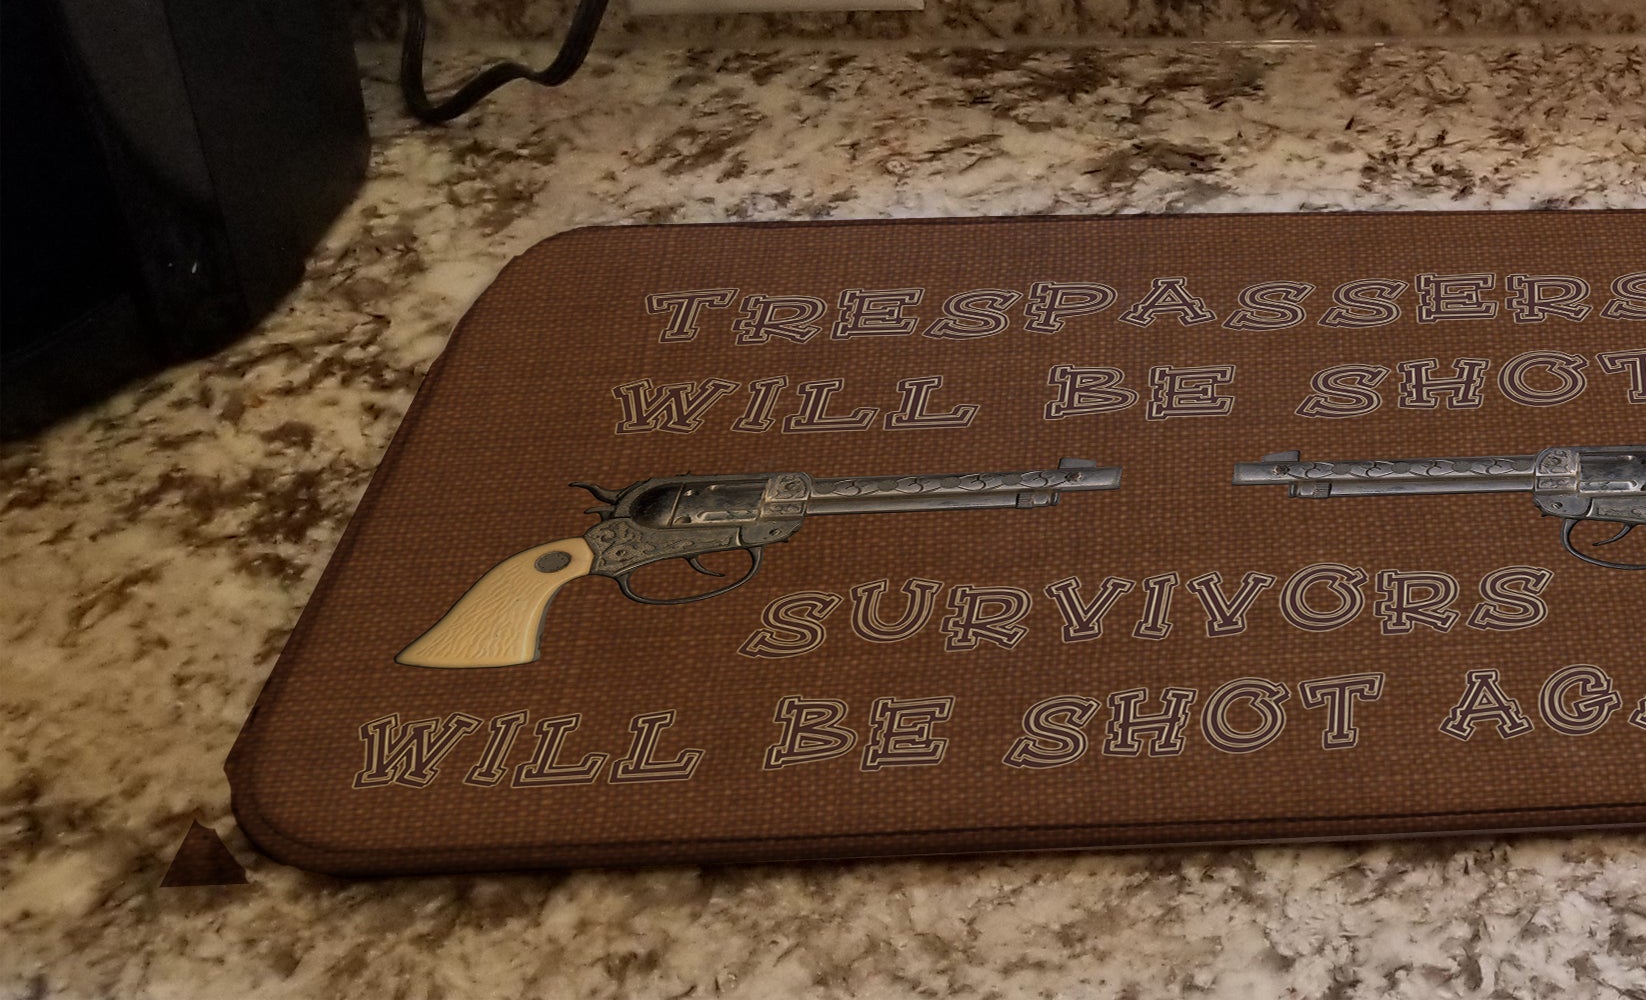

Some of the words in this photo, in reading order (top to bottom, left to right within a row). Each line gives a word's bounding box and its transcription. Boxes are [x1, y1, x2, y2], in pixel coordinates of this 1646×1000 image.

[611, 376, 980, 434] WILL
[1043, 364, 1236, 421] BE
[737, 563, 1555, 658] SURVIVORS
[352, 709, 704, 789] WILL
[762, 694, 956, 771] BE
[1002, 671, 1386, 769] SHOT
